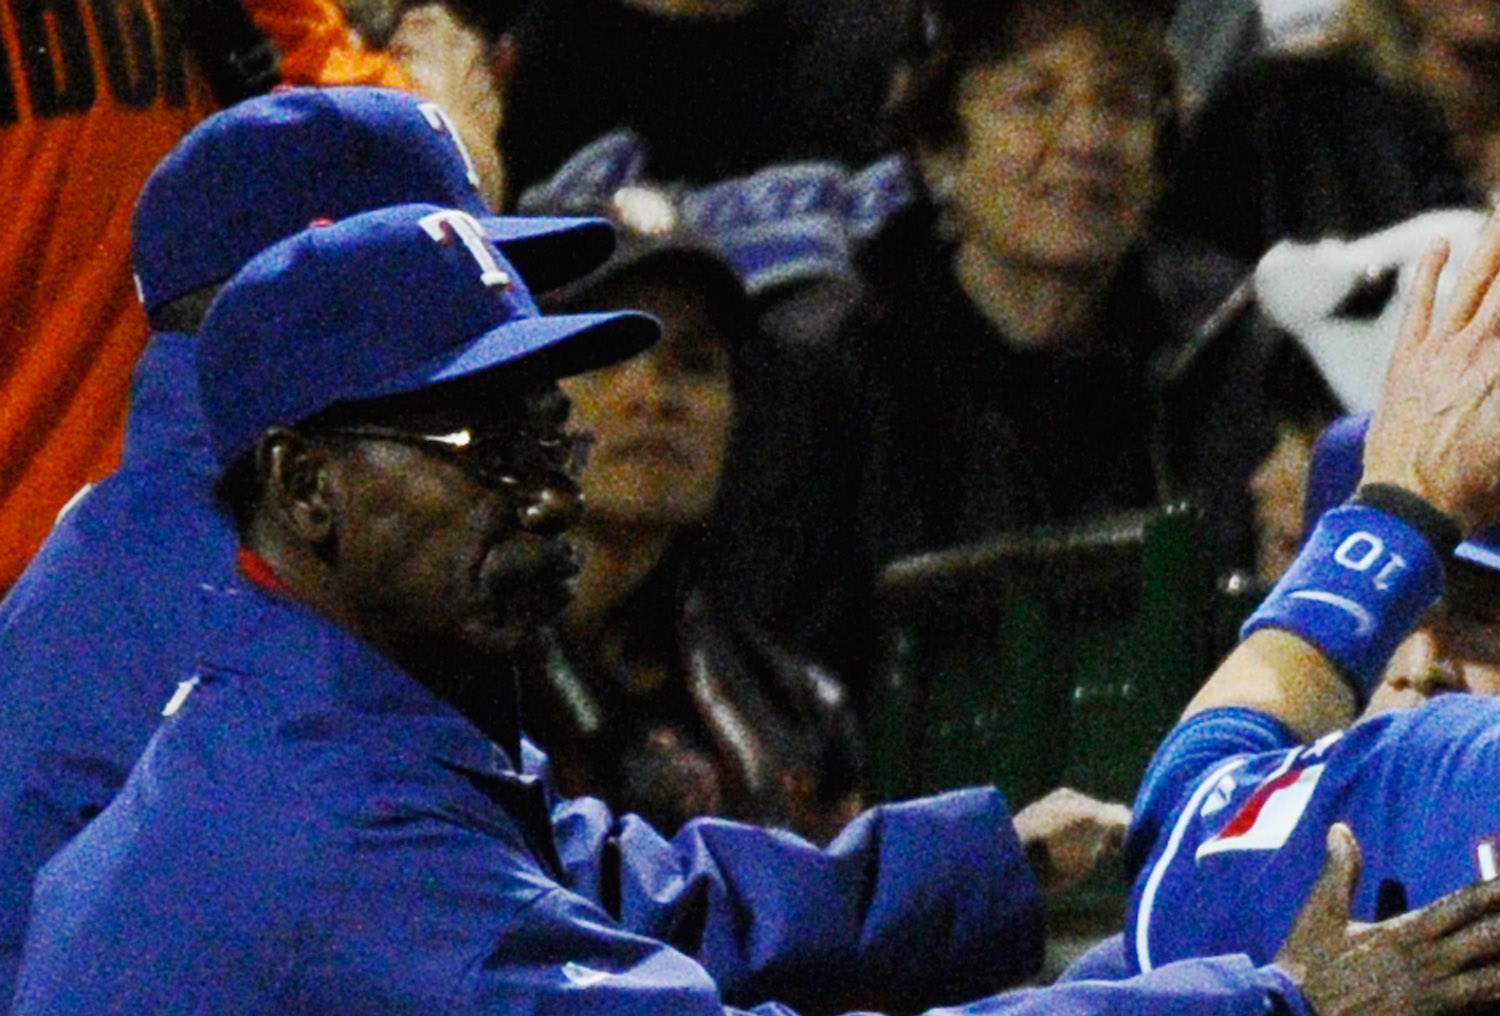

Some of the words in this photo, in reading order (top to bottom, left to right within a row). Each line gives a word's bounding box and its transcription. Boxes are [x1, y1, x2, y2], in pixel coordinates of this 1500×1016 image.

[417, 102, 482, 190] T
[417, 208, 513, 290] T
[1333, 530, 1407, 591] 10
